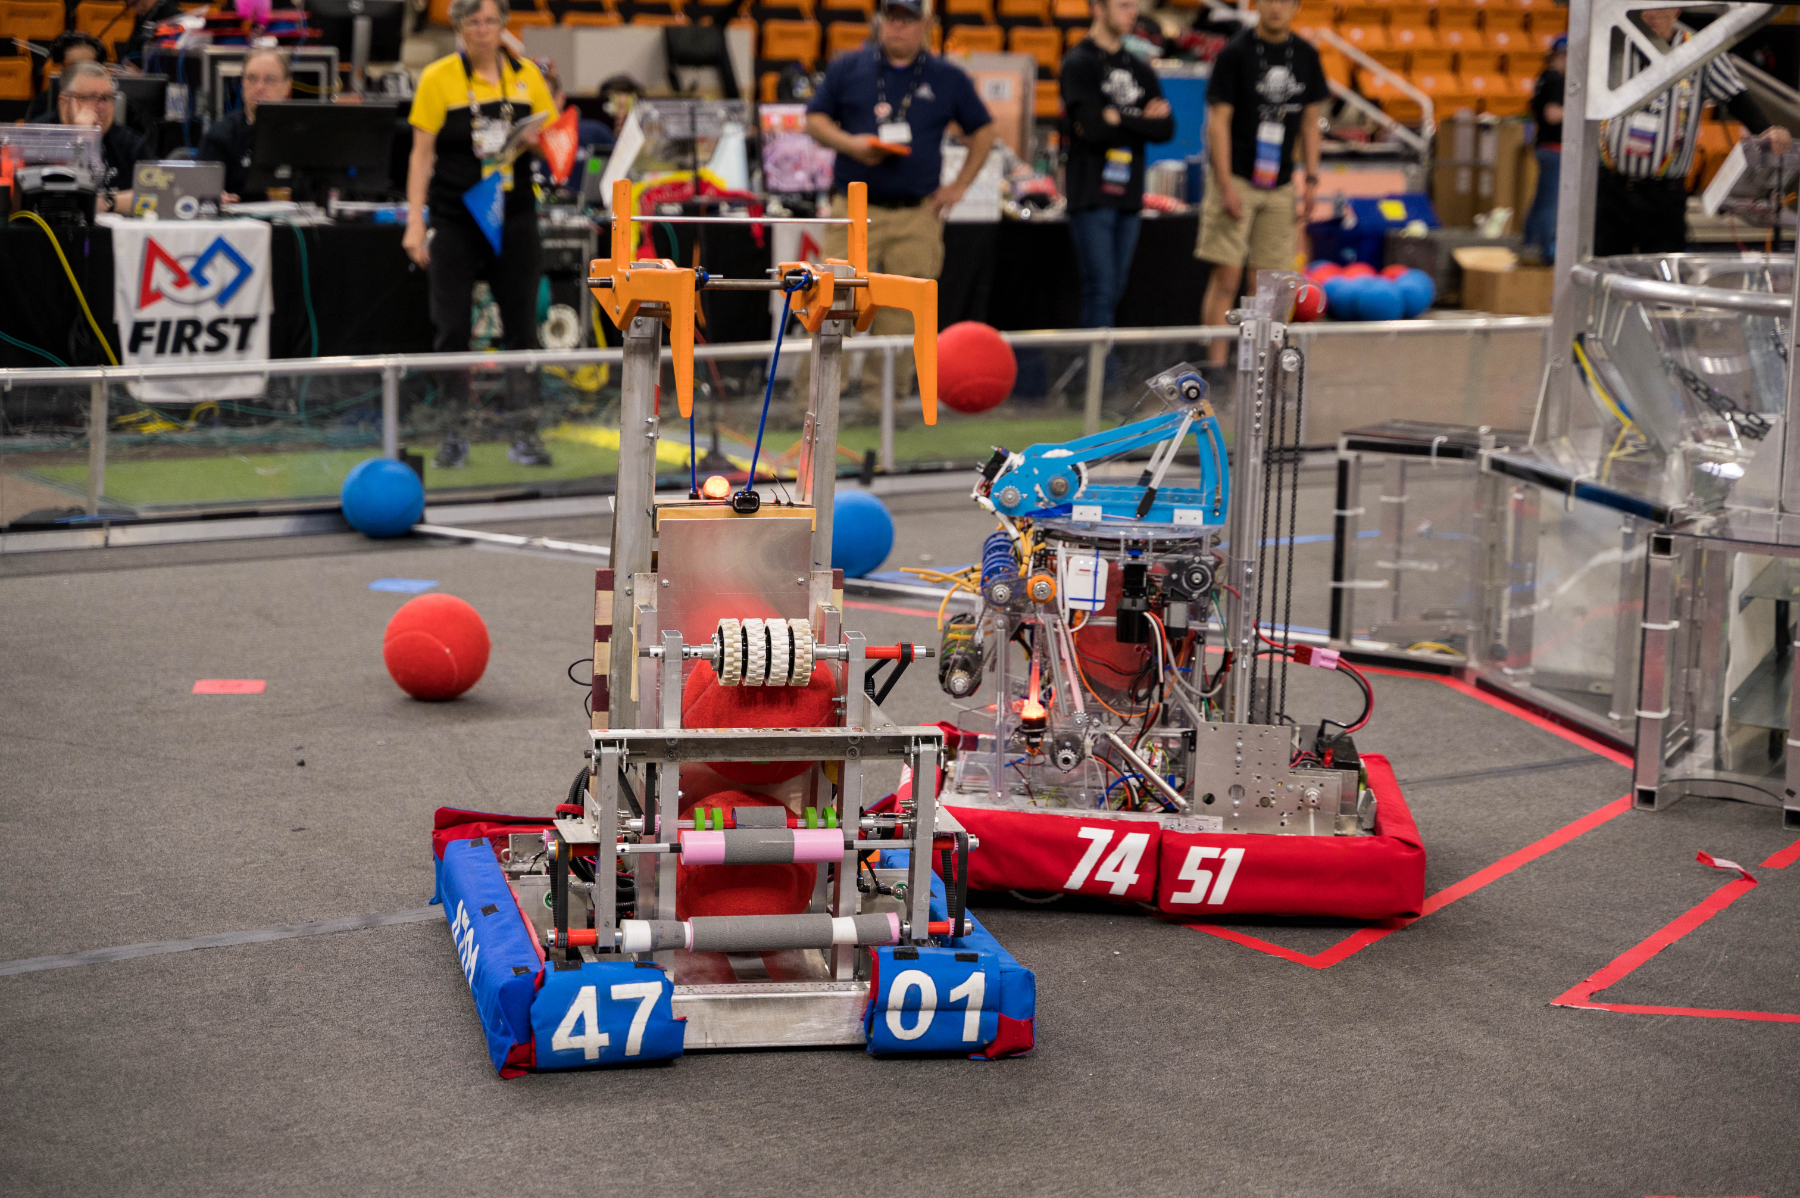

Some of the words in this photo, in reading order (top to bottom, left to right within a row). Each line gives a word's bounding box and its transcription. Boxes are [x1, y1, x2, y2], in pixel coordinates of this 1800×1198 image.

[128, 317, 257, 355] FIRST
[1063, 827, 1150, 895] 74
[1170, 846, 1246, 904] 51
[551, 981, 663, 1060] 47
[885, 969, 985, 1042] 01
